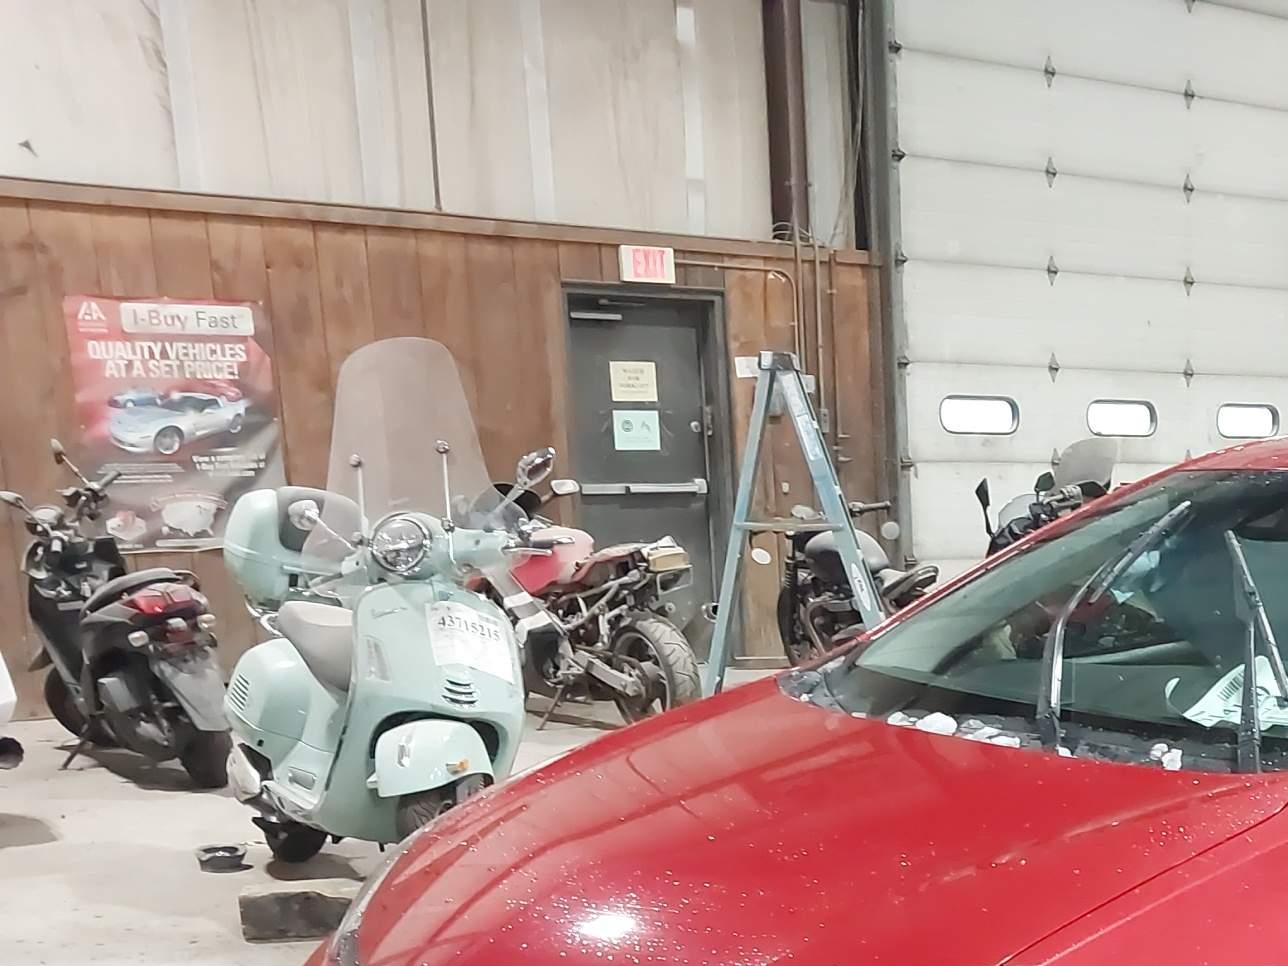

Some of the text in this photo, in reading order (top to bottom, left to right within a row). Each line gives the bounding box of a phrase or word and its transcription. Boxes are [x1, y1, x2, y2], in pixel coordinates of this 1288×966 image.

[632, 248, 666, 278] EXIT
[132, 308, 188, 331] I-Buy
[196, 311, 238, 329] Fast
[87, 340, 247, 362] QUALITY VEHICLES
[105, 360, 239, 379] AT A SET PRICE!
